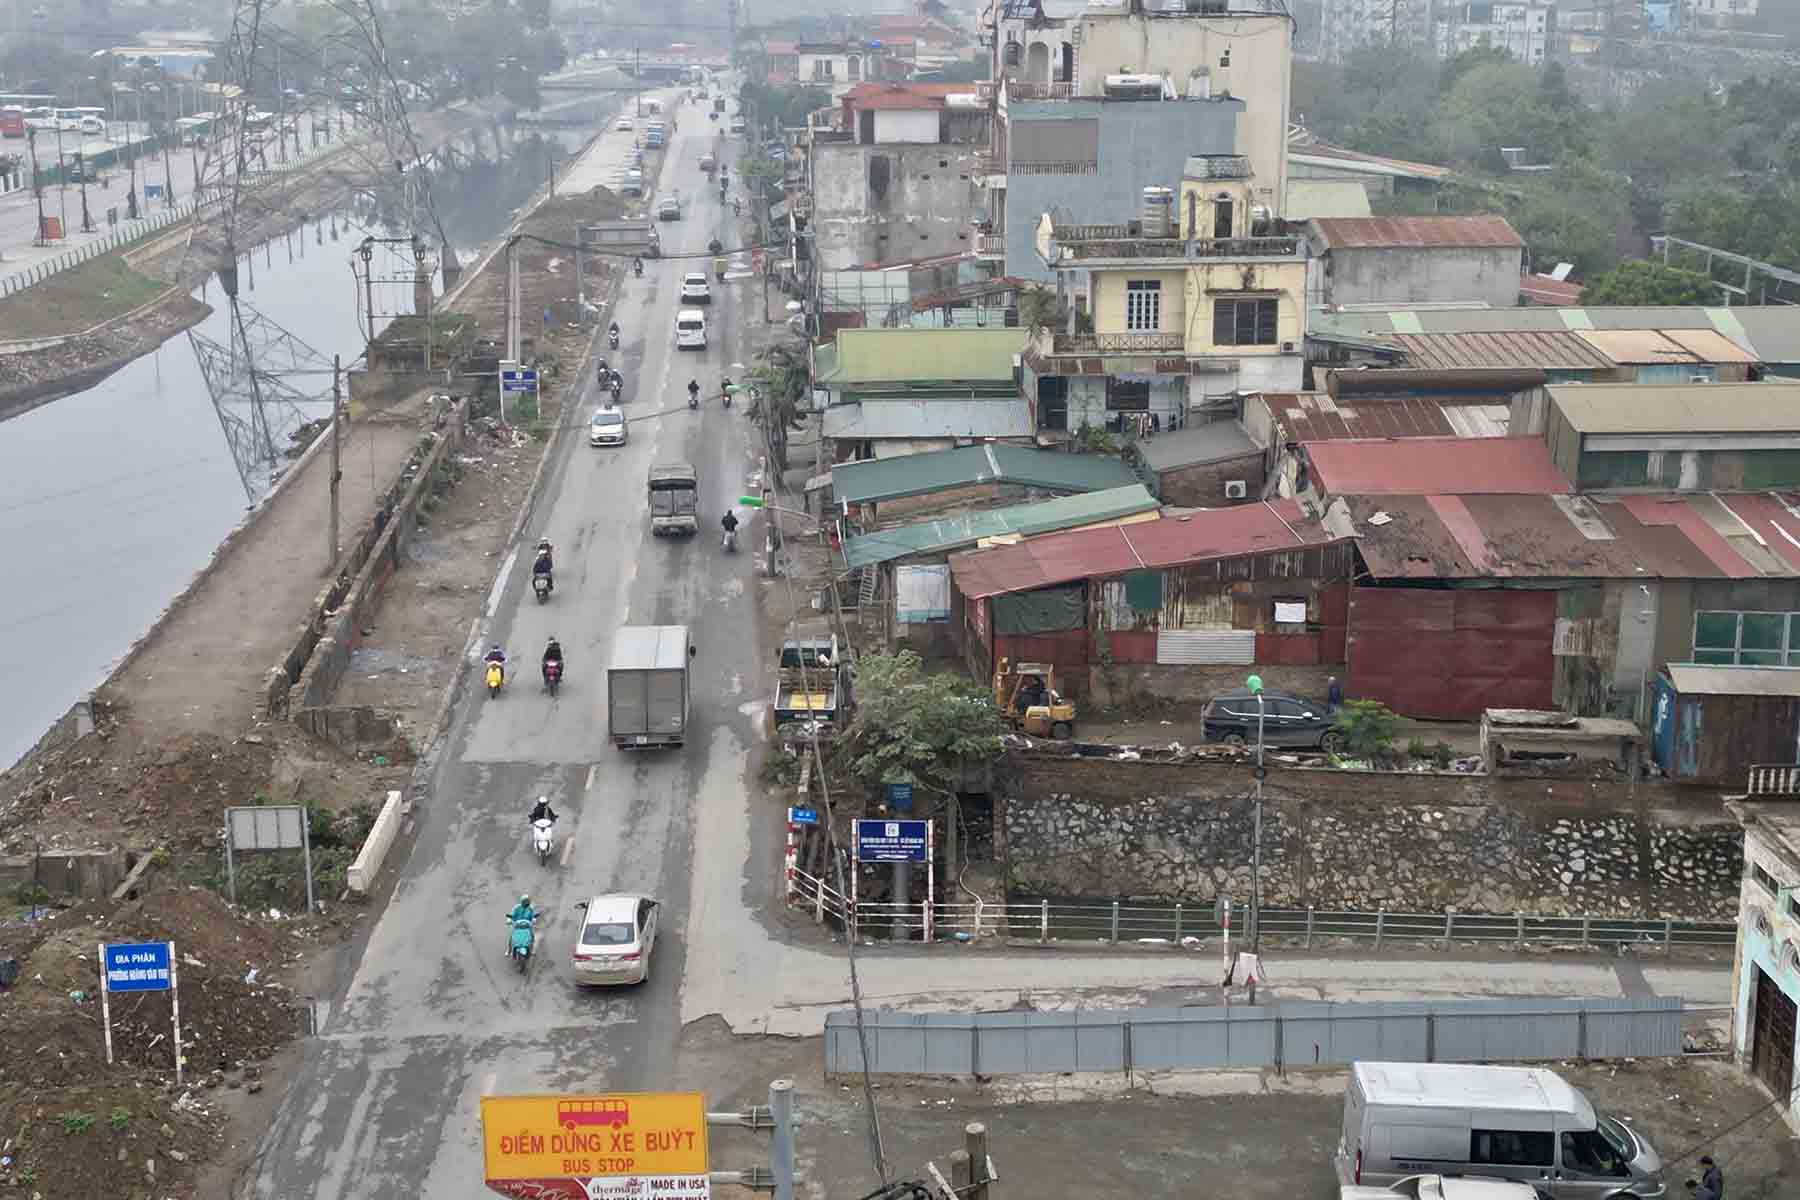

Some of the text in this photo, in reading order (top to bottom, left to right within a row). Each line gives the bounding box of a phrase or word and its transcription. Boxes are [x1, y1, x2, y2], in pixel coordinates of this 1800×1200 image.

[610, 1133, 635, 1153] XE
[646, 1128, 696, 1152] BUÝT
[563, 1158, 634, 1173] BUS STOP
[651, 1178, 706, 1191] MADE IN USA
